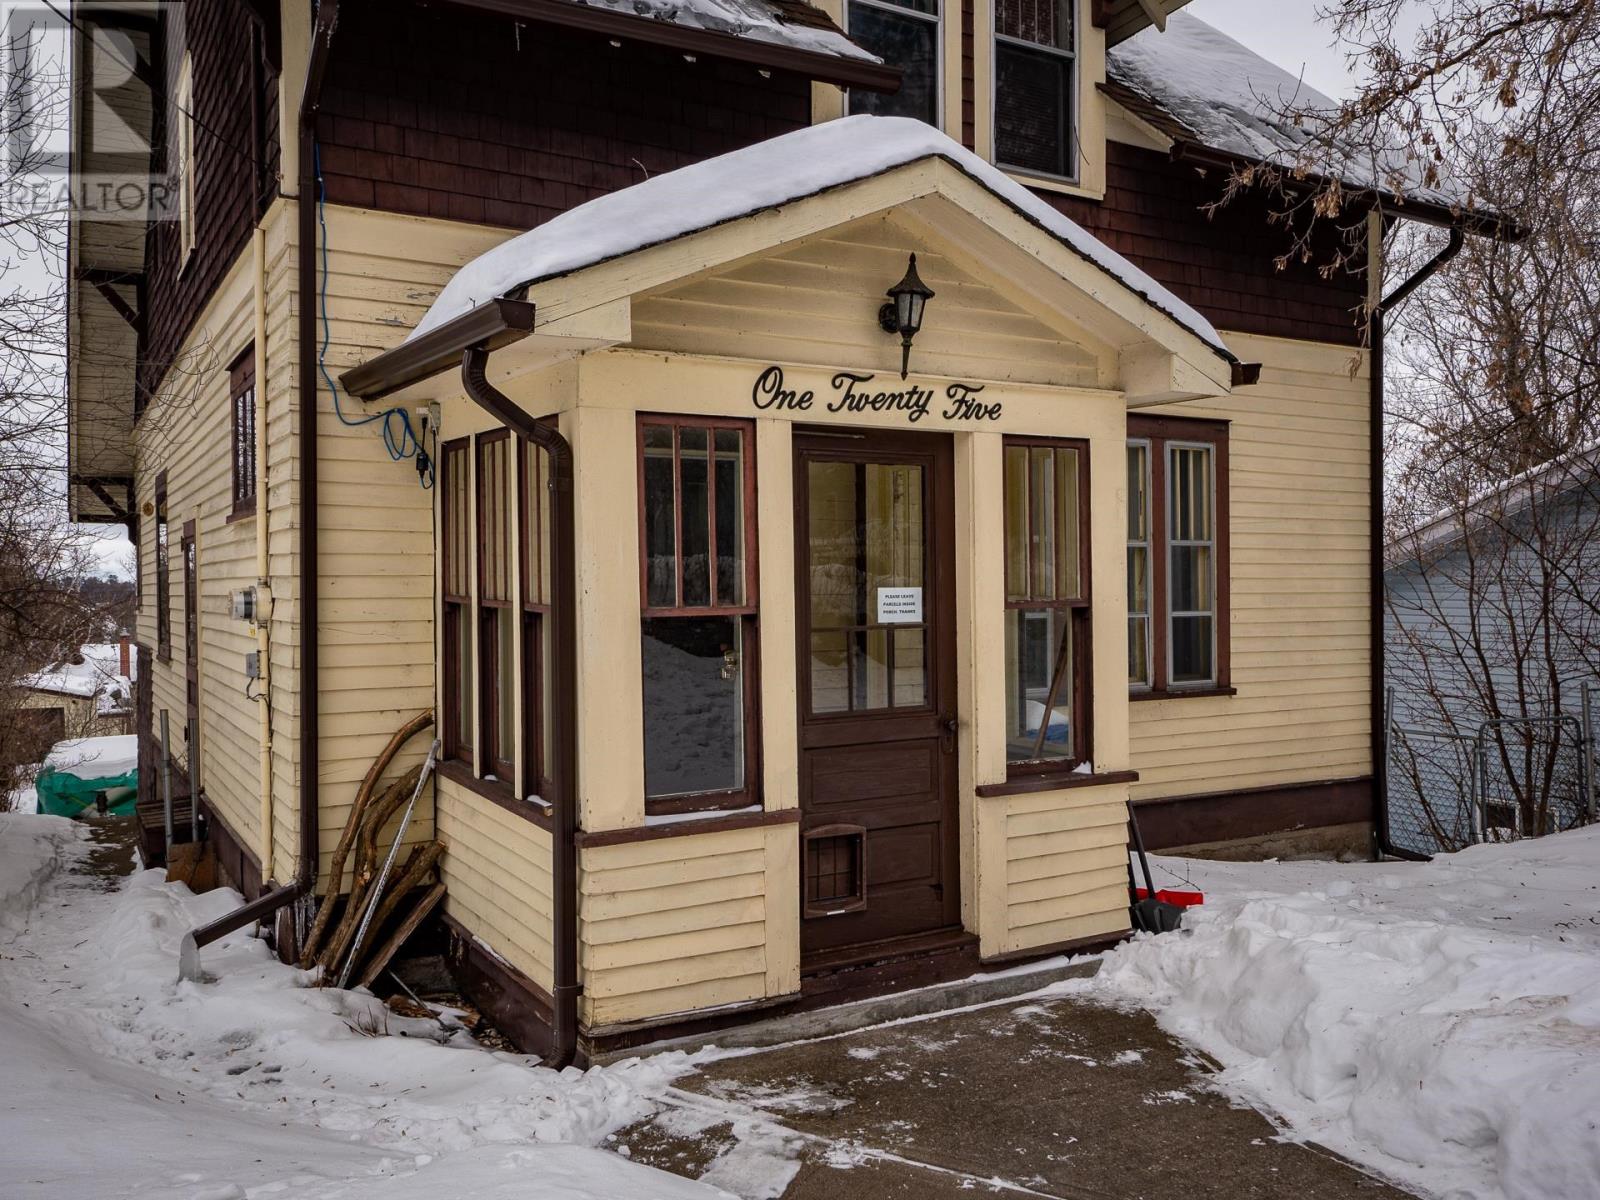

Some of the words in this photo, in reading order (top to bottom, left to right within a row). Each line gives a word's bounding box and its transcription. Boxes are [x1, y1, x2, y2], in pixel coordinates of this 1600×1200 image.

[752, 366, 814, 410] One
[827, 373, 934, 422] Twenty
[943, 383, 1002, 421] Five
